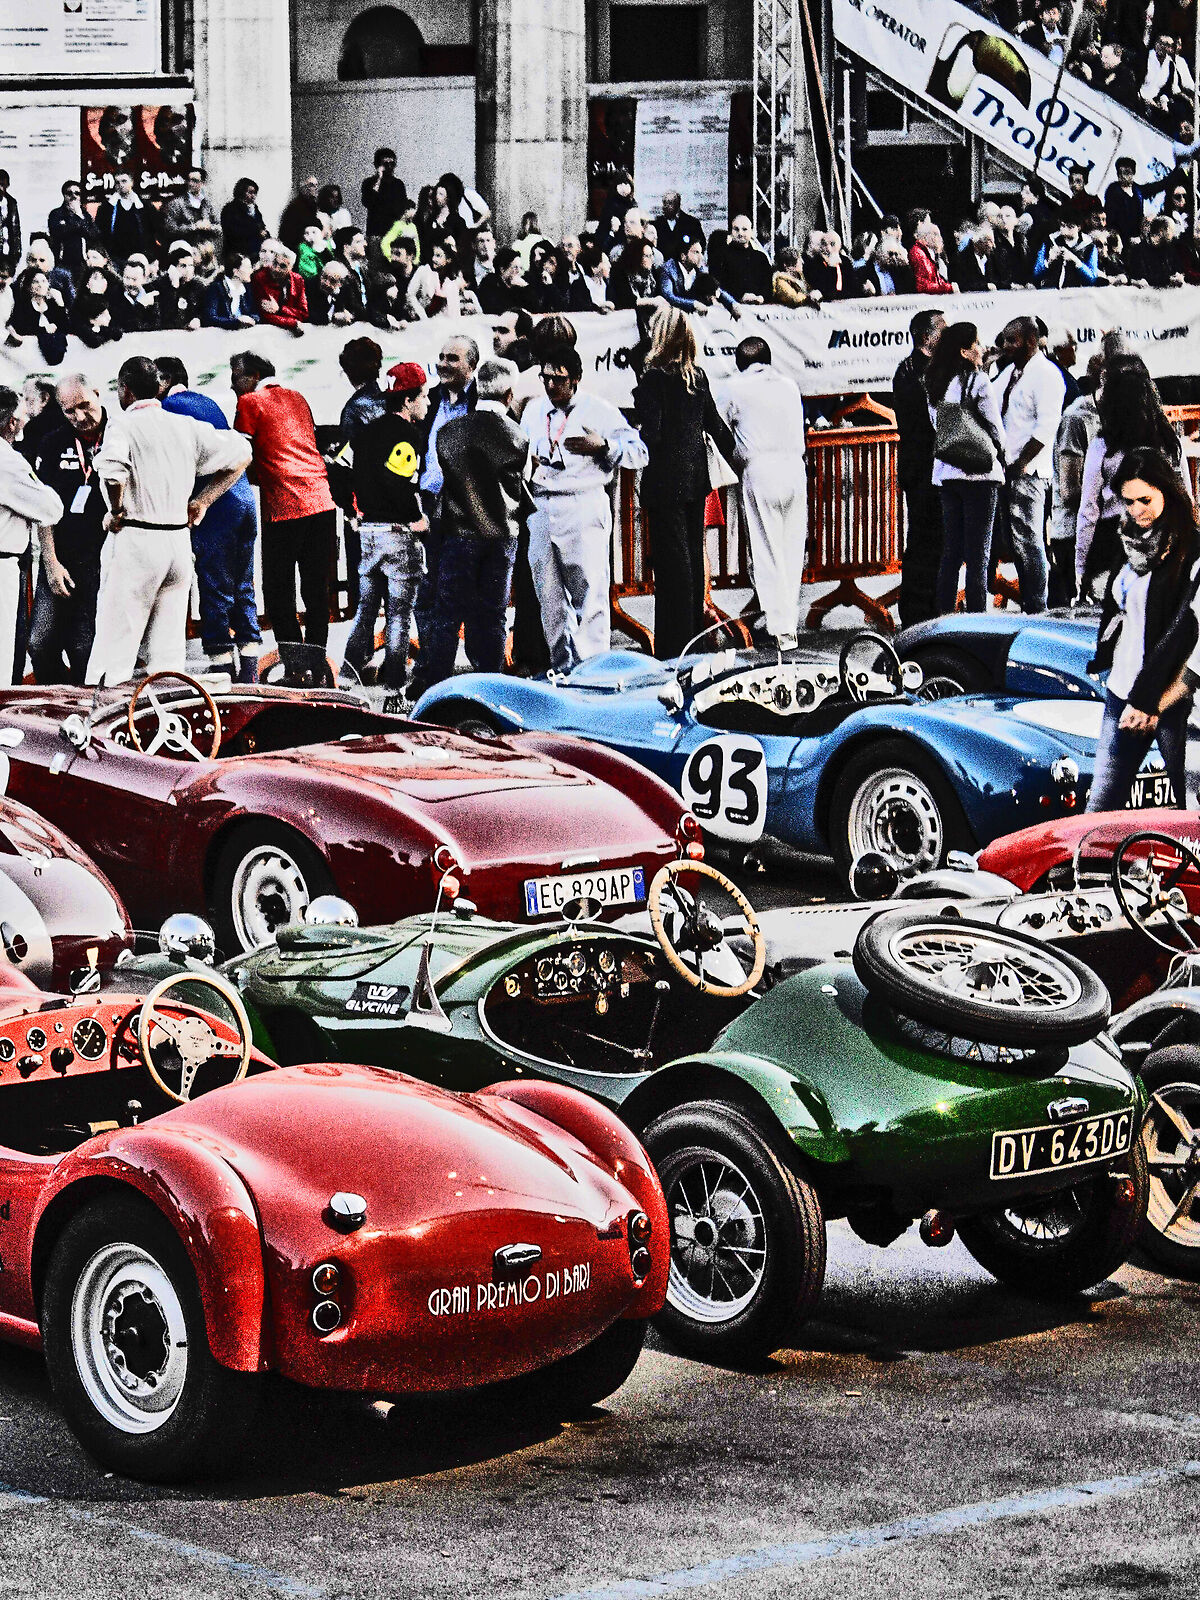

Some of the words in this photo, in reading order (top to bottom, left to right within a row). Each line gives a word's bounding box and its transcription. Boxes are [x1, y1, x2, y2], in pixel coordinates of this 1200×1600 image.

[687, 743, 763, 827] 93
[345, 1000, 401, 1015] GLYCINE
[428, 1285, 470, 1316] GRAN
[476, 1274, 542, 1311] PREMIO
[545, 1270, 560, 1300] DI
[563, 1261, 591, 1296] BARI
